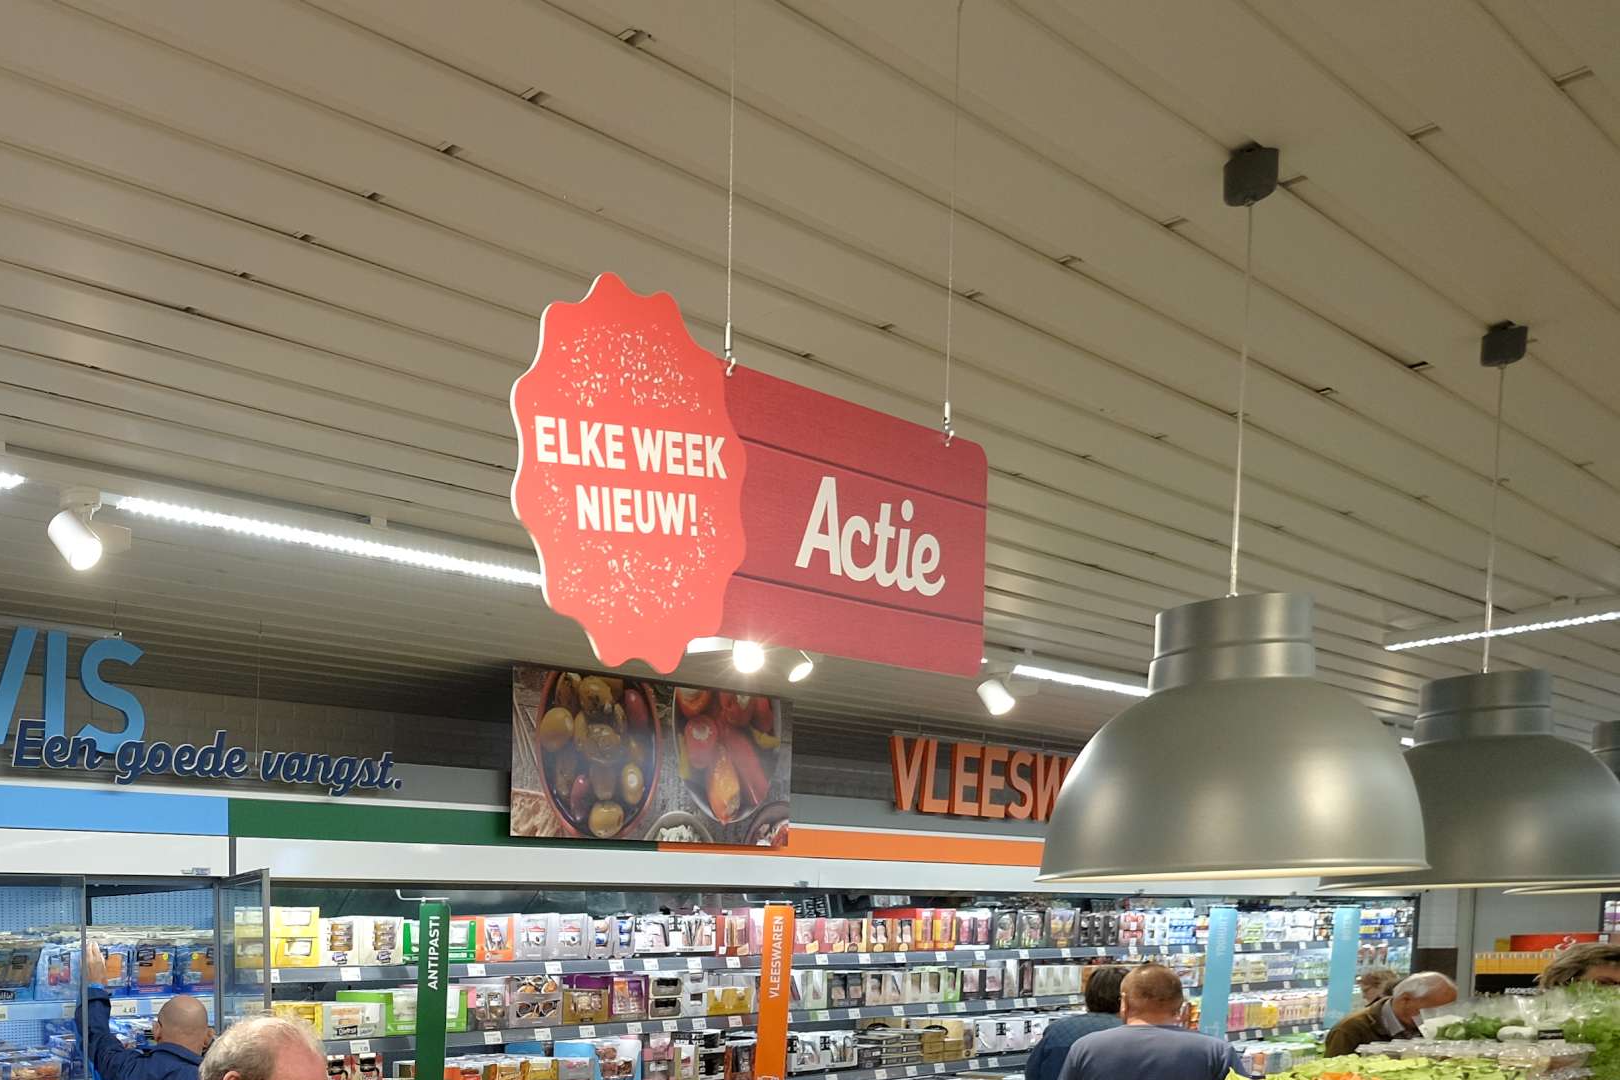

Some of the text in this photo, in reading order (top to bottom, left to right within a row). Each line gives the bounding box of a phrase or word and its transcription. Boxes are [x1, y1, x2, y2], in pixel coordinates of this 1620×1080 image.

[534, 415, 727, 480] ELKE WEEK
[575, 485, 699, 537] NIEUW!
[795, 476, 946, 598] Actie
[12, 717, 403, 796] Een goede vangst.
[426, 915, 441, 991] ANTIPASTI
[768, 916, 785, 999] VLEESWAREN
